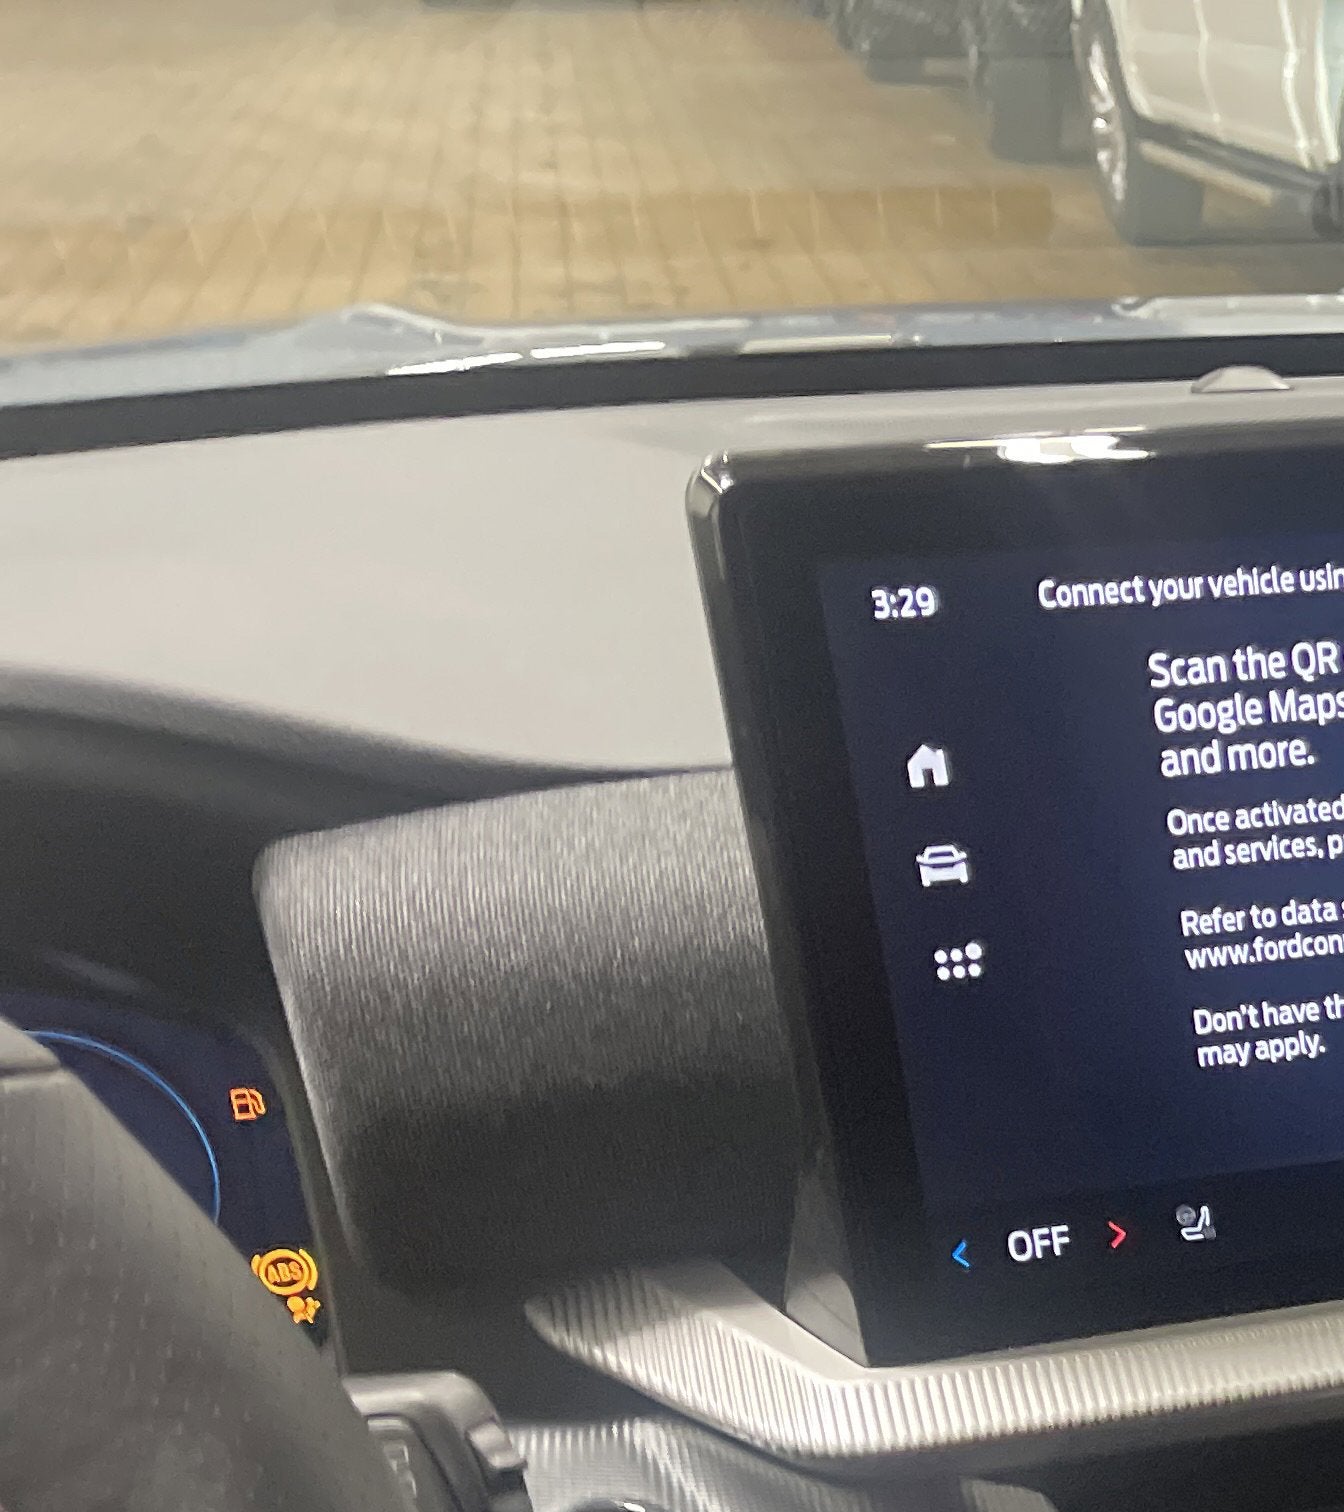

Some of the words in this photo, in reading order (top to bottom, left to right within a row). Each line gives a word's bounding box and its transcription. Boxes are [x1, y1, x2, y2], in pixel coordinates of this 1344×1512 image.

[871, 587, 937, 620] 3:29
[1038, 575, 1146, 609] Connect
[1147, 576, 1204, 608] your
[1207, 565, 1296, 598] vehicle
[1148, 652, 1230, 689] Scan
[1231, 645, 1288, 682] the
[1291, 640, 1341, 683] QR
[1153, 692, 1264, 735] Google
[1160, 738, 1223, 778] and
[1226, 738, 1316, 772] more.
[1166, 808, 1231, 836] Once
[1172, 838, 1222, 870] and
[1224, 834, 1325, 866] services,
[1180, 906, 1246, 937] Refer
[1249, 904, 1278, 930] to
[1280, 898, 1339, 926] data
[1193, 1004, 1260, 1036] Don't
[1261, 1000, 1320, 1028] have
[1197, 1041, 1251, 1068] may
[1254, 1029, 1326, 1064] apply.
[1006, 1224, 1071, 1263] OFF
[267, 1260, 302, 1283] ABS
